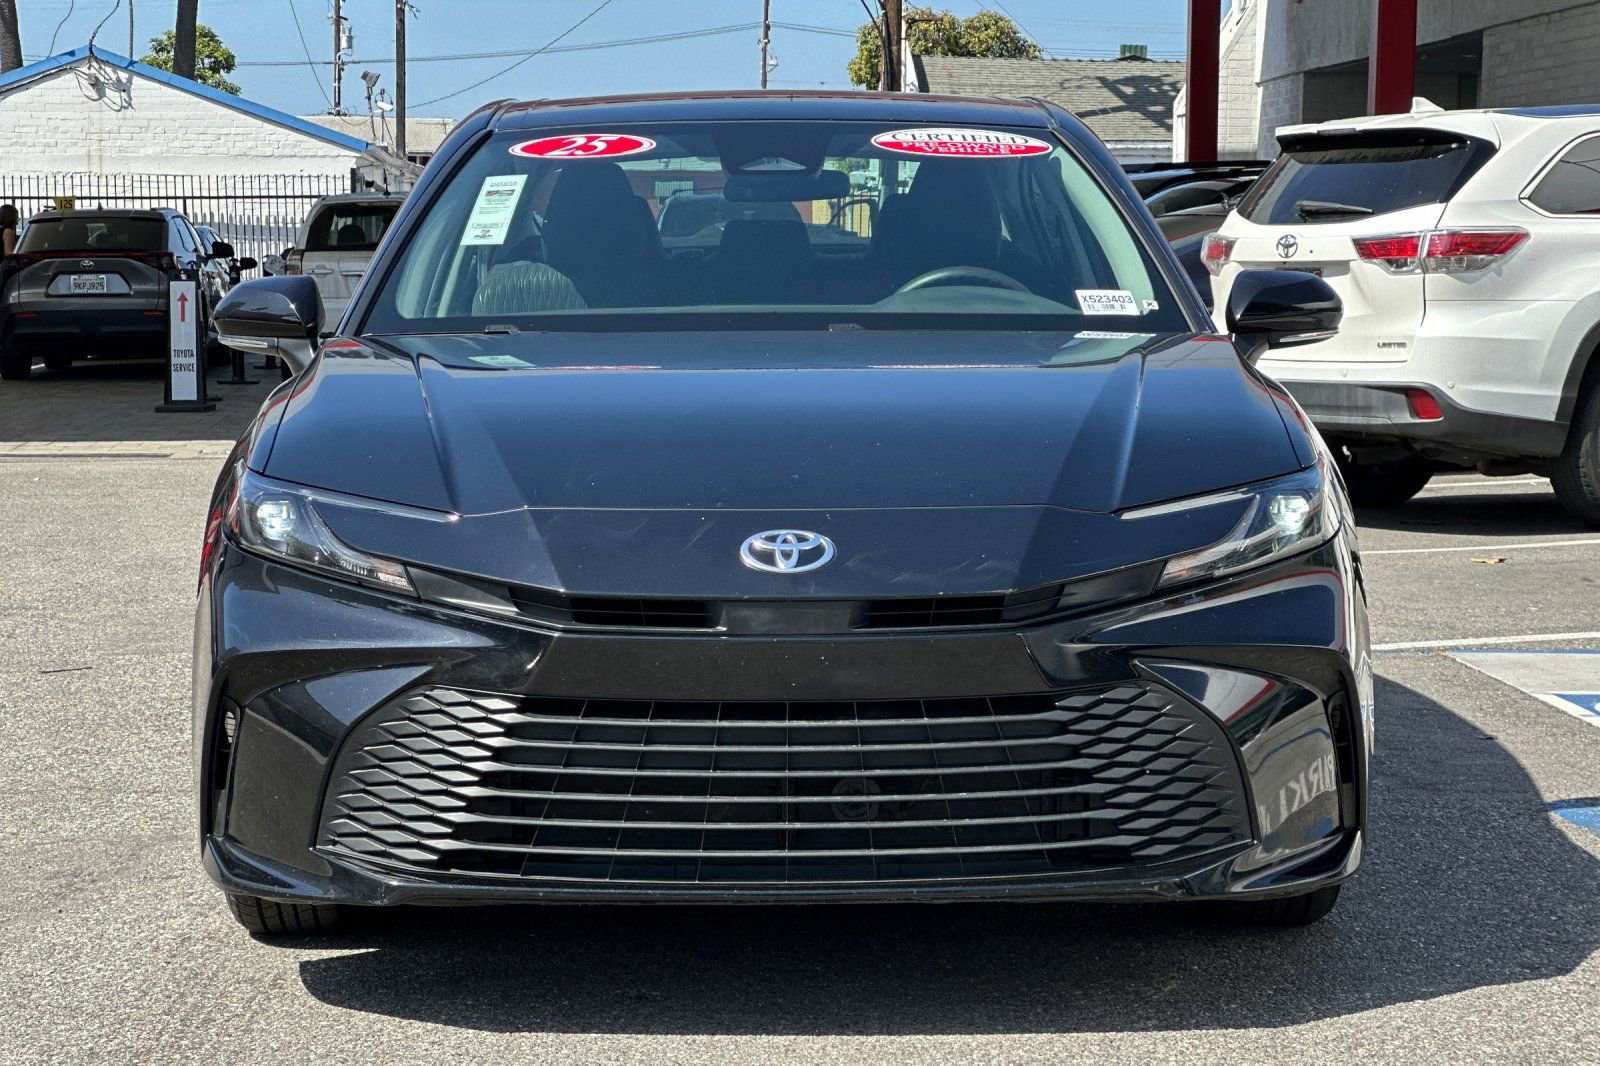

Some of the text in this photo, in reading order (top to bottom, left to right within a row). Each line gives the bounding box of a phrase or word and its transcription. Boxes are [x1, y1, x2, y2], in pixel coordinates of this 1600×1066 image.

[891, 133, 1029, 146] CERTIFIED
[543, 136, 622, 156] 25
[902, 142, 1026, 151] PRE-OWNED
[923, 147, 1012, 155] VEHICLE
[1081, 295, 1134, 304] X523403
[173, 349, 195, 358] TOYOTA
[172, 363, 196, 372] SERVICE
